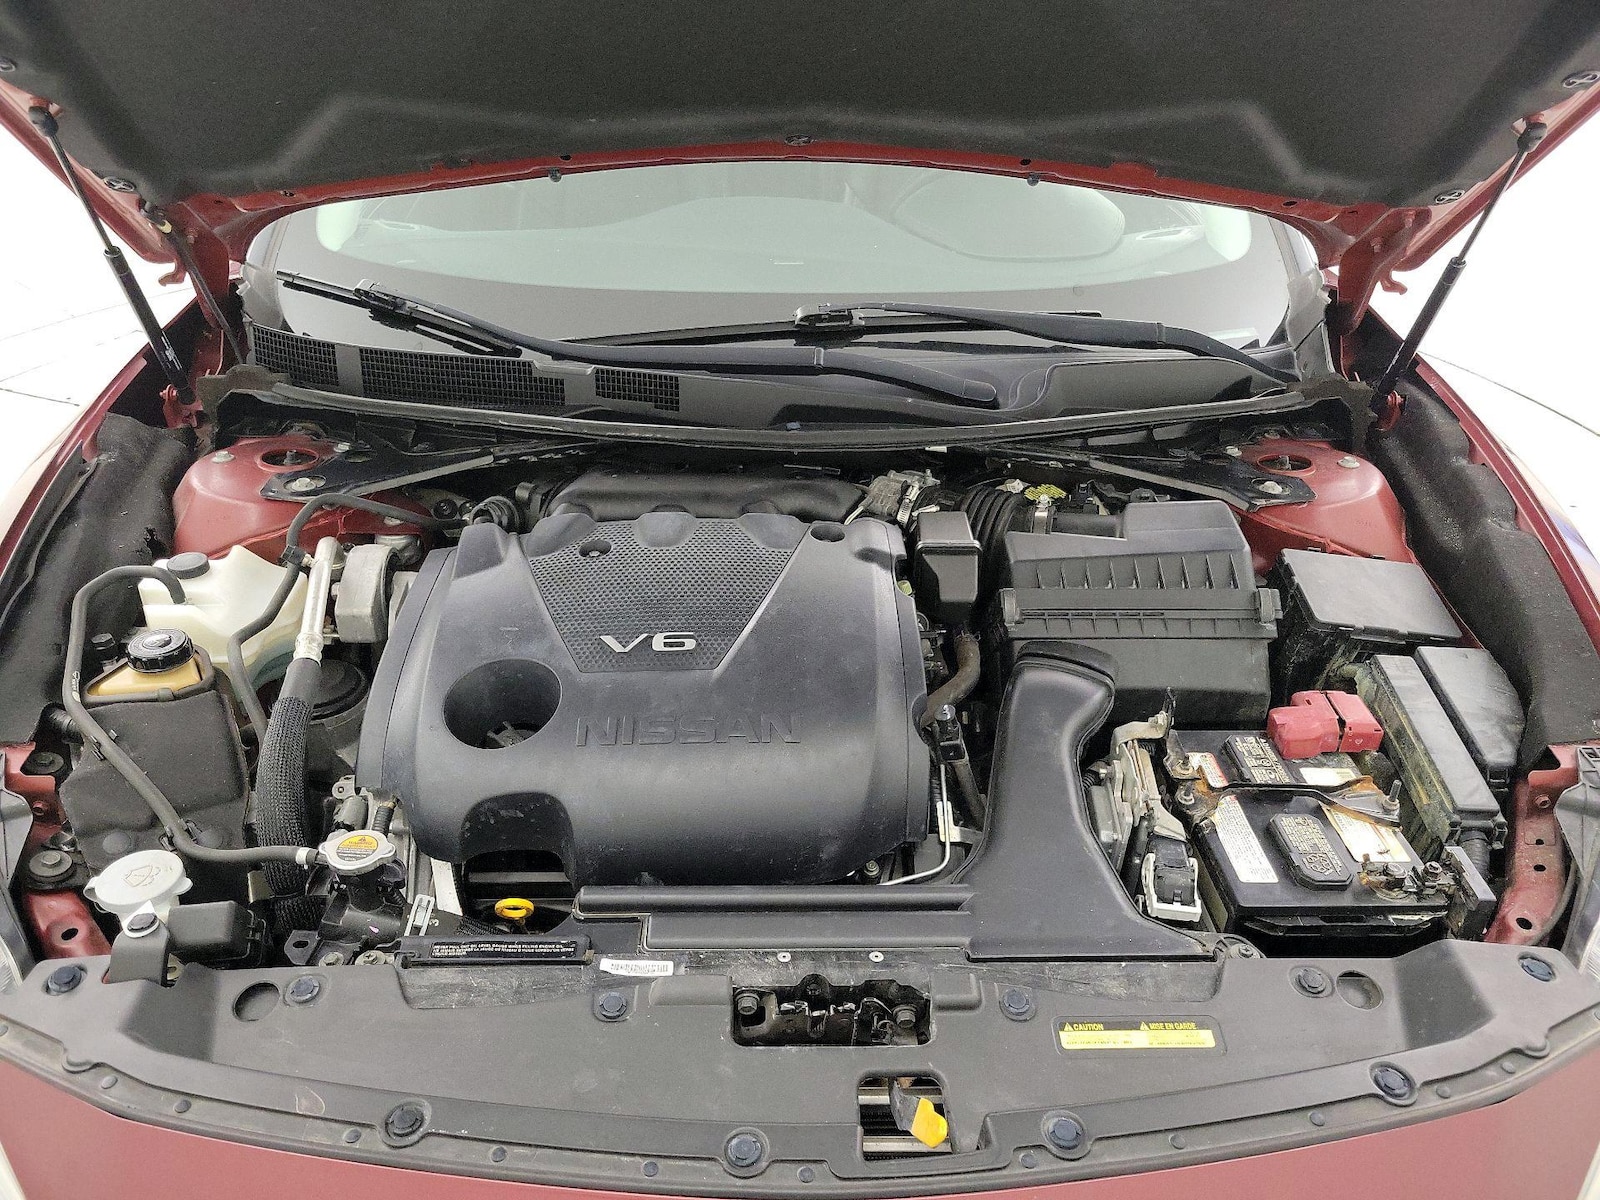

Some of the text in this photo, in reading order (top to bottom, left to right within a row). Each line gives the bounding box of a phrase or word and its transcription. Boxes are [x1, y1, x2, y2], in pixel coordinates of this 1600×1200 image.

[600, 631, 698, 654] V6
[576, 713, 801, 747] NISSAN
[1073, 1022, 1104, 1031] CAUTION
